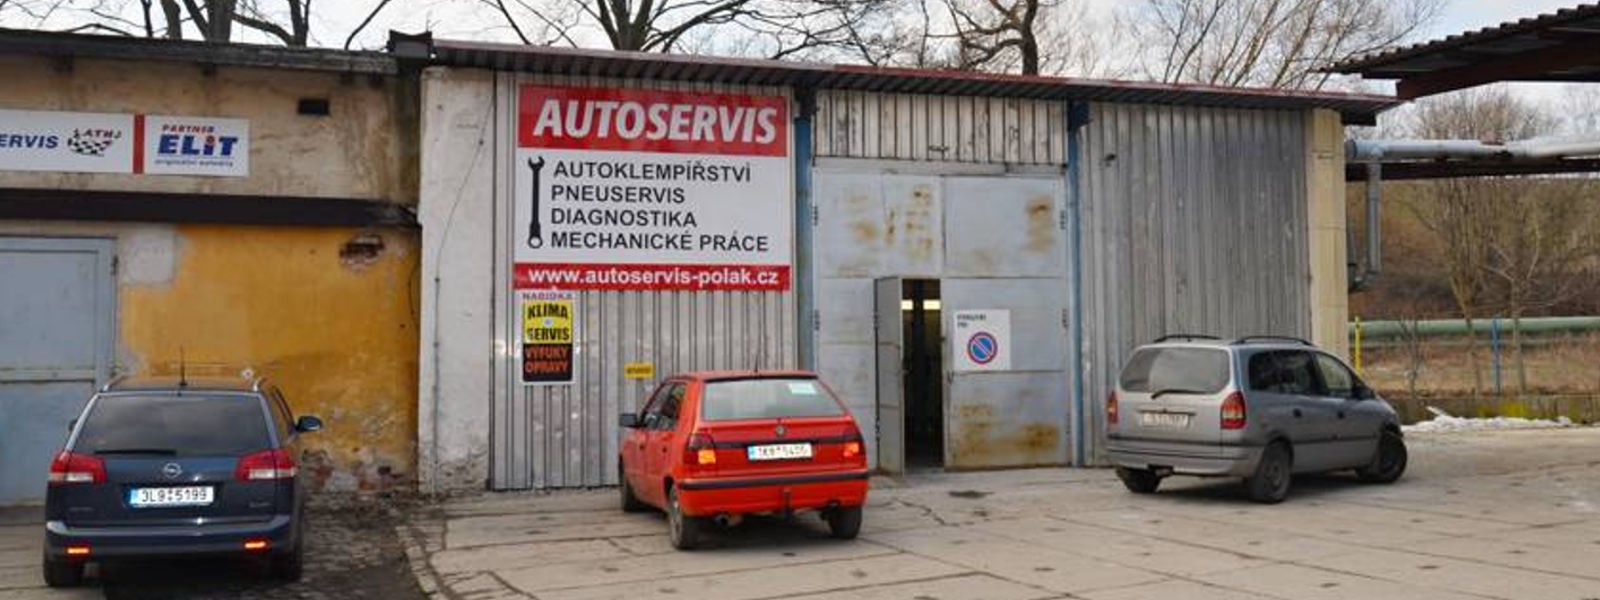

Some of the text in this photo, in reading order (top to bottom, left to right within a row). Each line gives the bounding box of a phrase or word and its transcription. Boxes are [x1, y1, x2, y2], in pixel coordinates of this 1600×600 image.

[532, 98, 778, 145] AUTOSERVIS
[553, 160, 751, 183] AUTOKLEMPÍŘSTVÍ
[551, 184, 686, 204] PNEUSERVIS
[551, 207, 698, 228] DIAGNOSTIKA
[551, 230, 769, 252] MECHANICKÉ PRÁCE
[528, 266, 780, 288] www.autoservis-polak.cz
[527, 303, 568, 320] KLIMA
[526, 327, 570, 341] SERVIS
